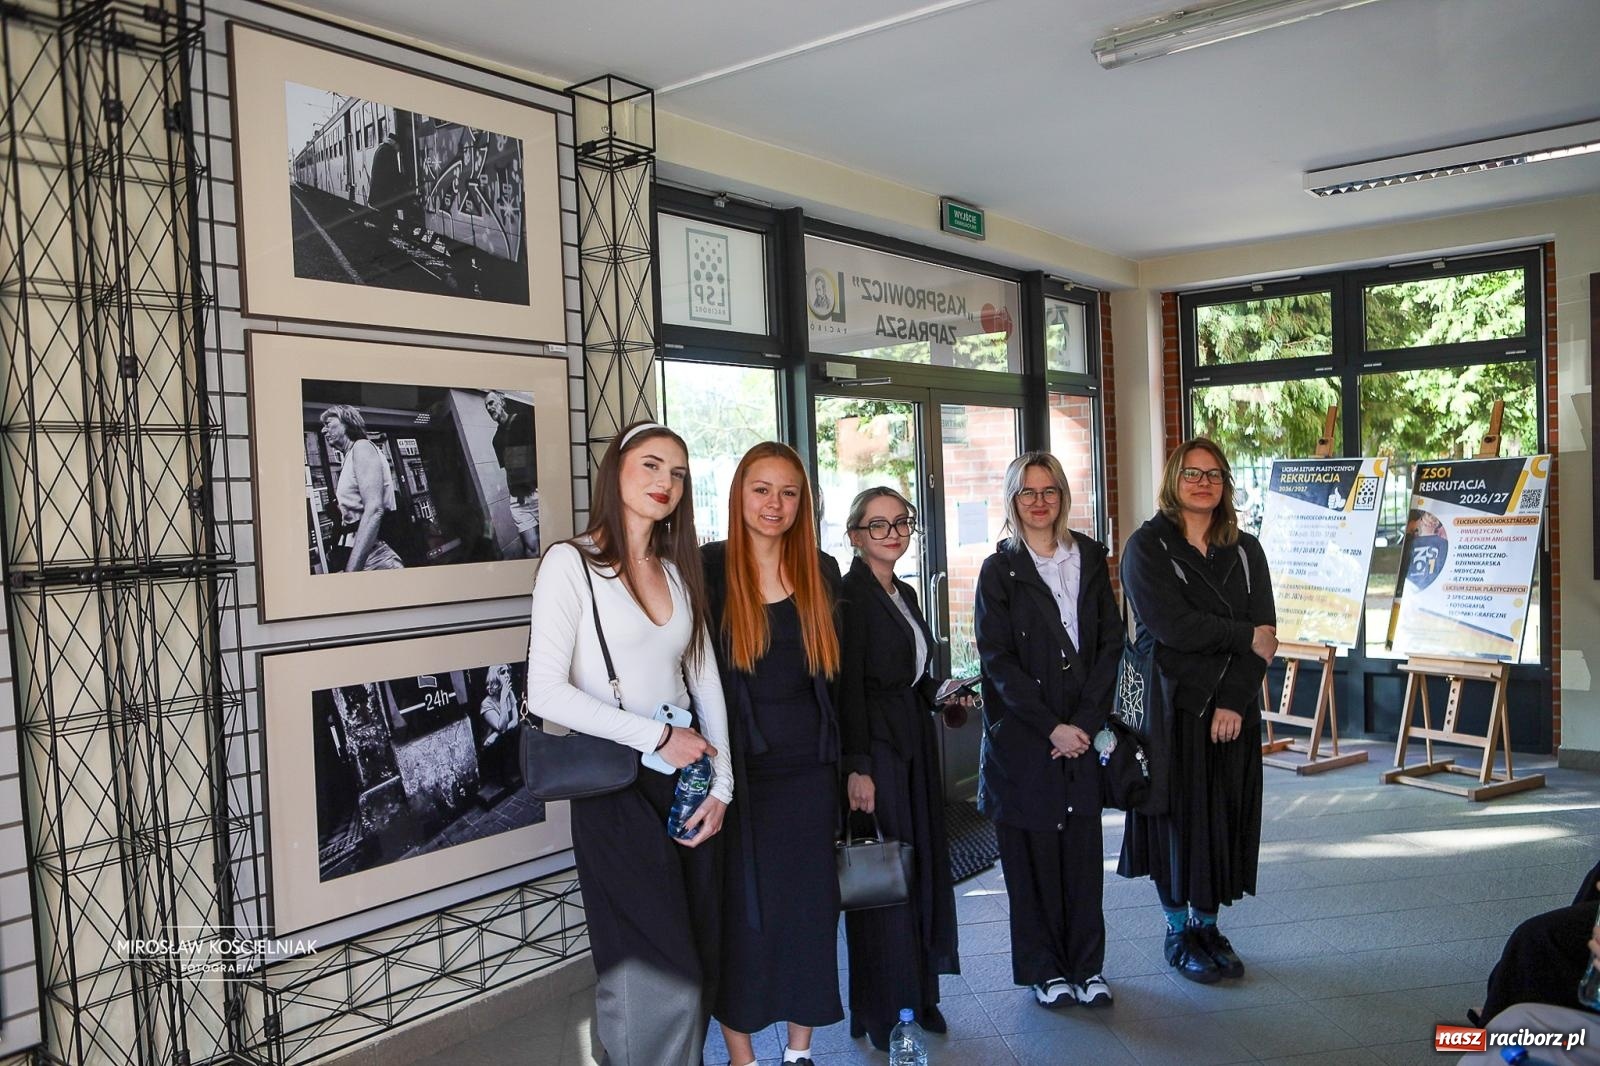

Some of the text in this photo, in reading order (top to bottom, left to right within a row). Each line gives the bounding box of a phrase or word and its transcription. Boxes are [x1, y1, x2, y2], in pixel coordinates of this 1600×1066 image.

[954, 209, 977, 225] WYJŚCIE
[1280, 472, 1340, 483] REKRUTACJA
[1422, 466, 1452, 479] ZSO1
[1419, 480, 1486, 492] REKRUTACJA
[1356, 496, 1373, 505] LSP
[1460, 492, 1509, 505] 2026/27
[424, 689, 450, 711] 24h
